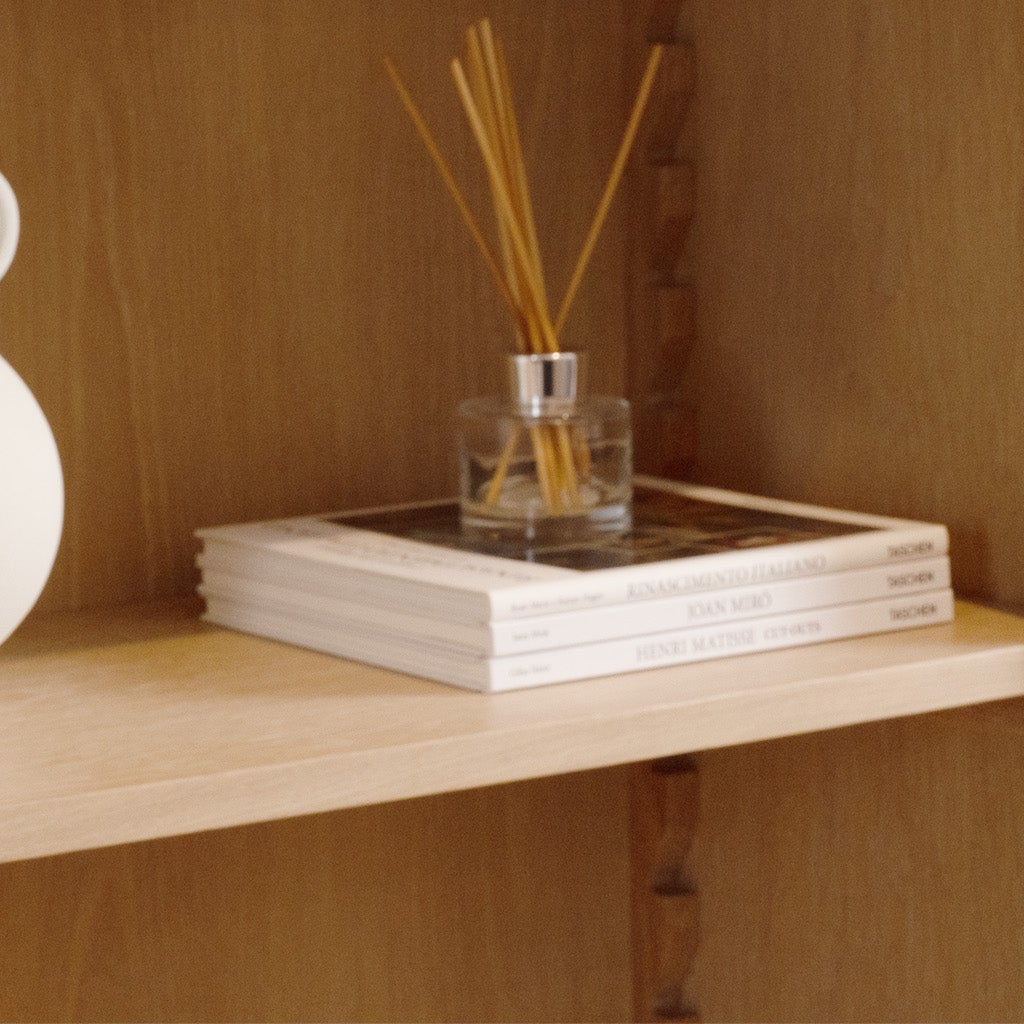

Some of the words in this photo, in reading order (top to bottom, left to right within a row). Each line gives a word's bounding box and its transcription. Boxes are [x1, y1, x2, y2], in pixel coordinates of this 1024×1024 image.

[888, 540, 934, 558] TASCHEN
[887, 572, 934, 589] TASCHEN
[687, 598, 726, 621] JOAN
[890, 603, 938, 621] TASCHEN
[636, 638, 687, 662] HENRI
[692, 627, 756, 653] MATISSE
